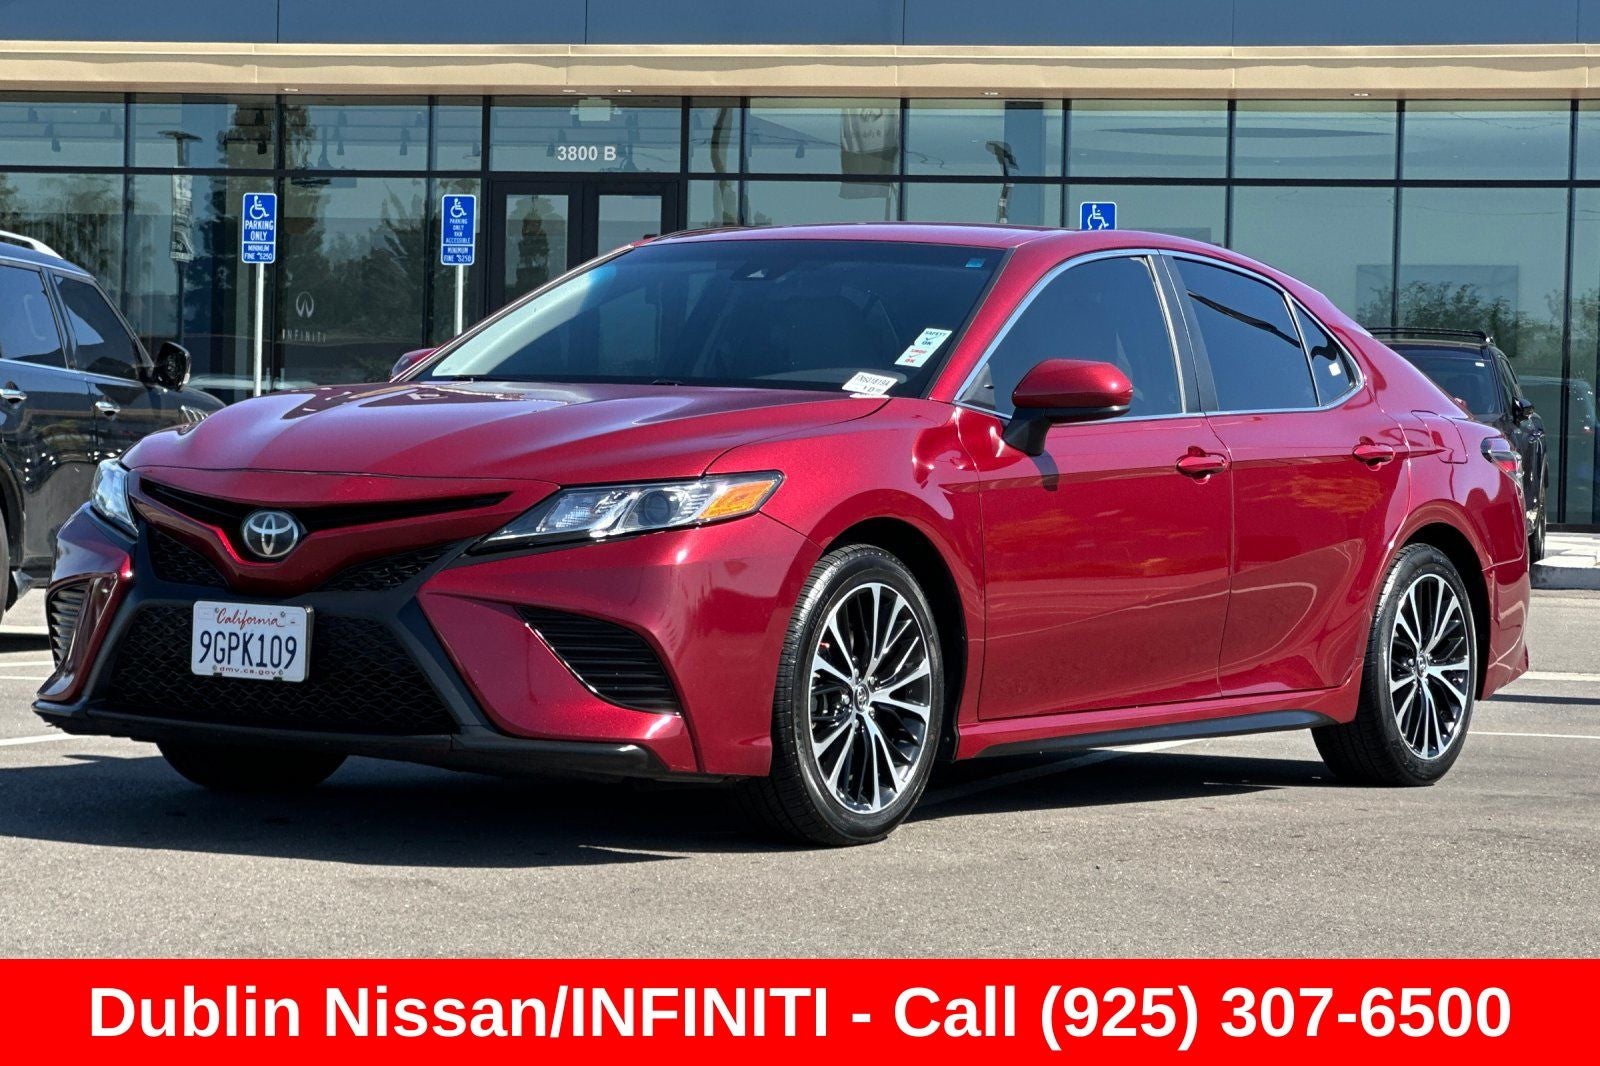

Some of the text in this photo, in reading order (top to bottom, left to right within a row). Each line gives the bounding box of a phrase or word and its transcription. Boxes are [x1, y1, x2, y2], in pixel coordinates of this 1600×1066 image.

[557, 145, 617, 161] 3800 B
[244, 220, 275, 231] PARKING
[250, 230, 268, 241] ONLY
[247, 244, 270, 252] MINIMUM
[244, 252, 256, 260] FINE
[216, 607, 286, 631] California
[198, 630, 298, 671] 9GPK109
[219, 665, 277, 677] dmv.ca.gov
